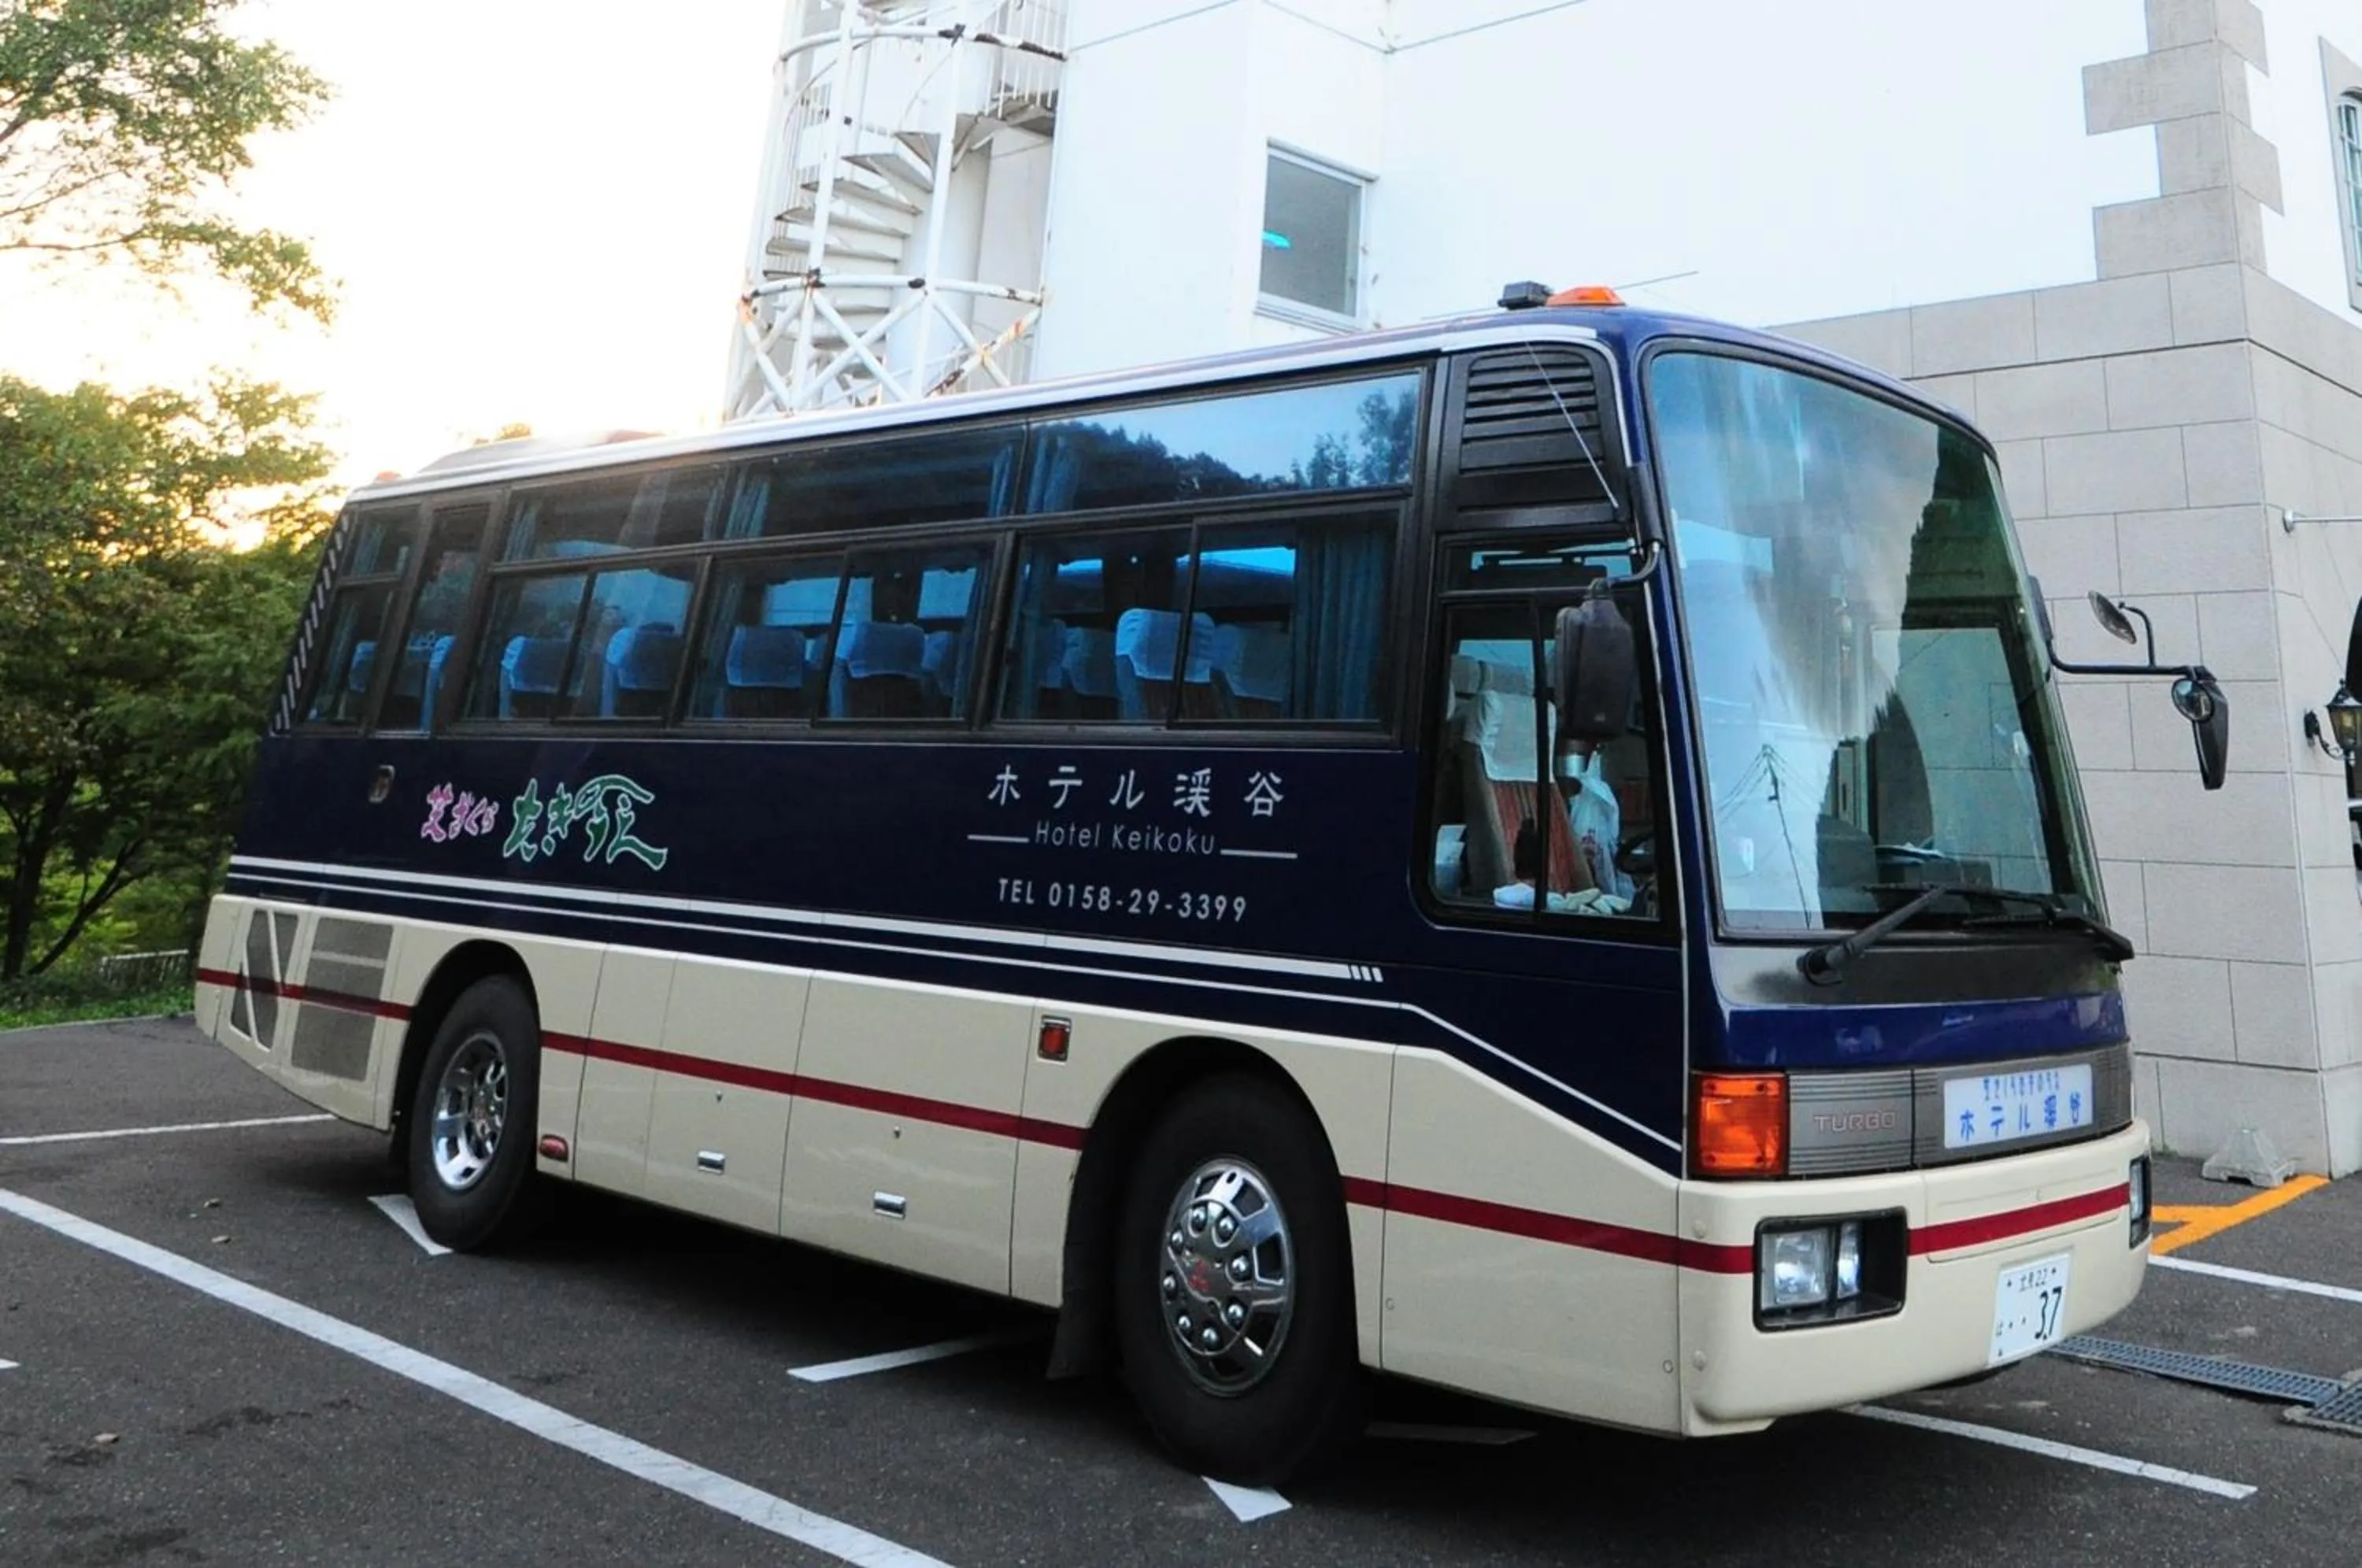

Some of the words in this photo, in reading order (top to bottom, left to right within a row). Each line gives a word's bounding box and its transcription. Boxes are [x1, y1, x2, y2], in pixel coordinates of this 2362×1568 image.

[987, 764, 1284, 817] ホテル渓谷
[1035, 821, 1101, 849] Hotel
[1111, 824, 1215, 855] Keikoku
[998, 878, 1035, 904] TEL
[1048, 882, 1247, 922] 0158-29-3399
[1813, 1111, 1897, 1133] TURBO
[2034, 1285, 2063, 1339] 37
